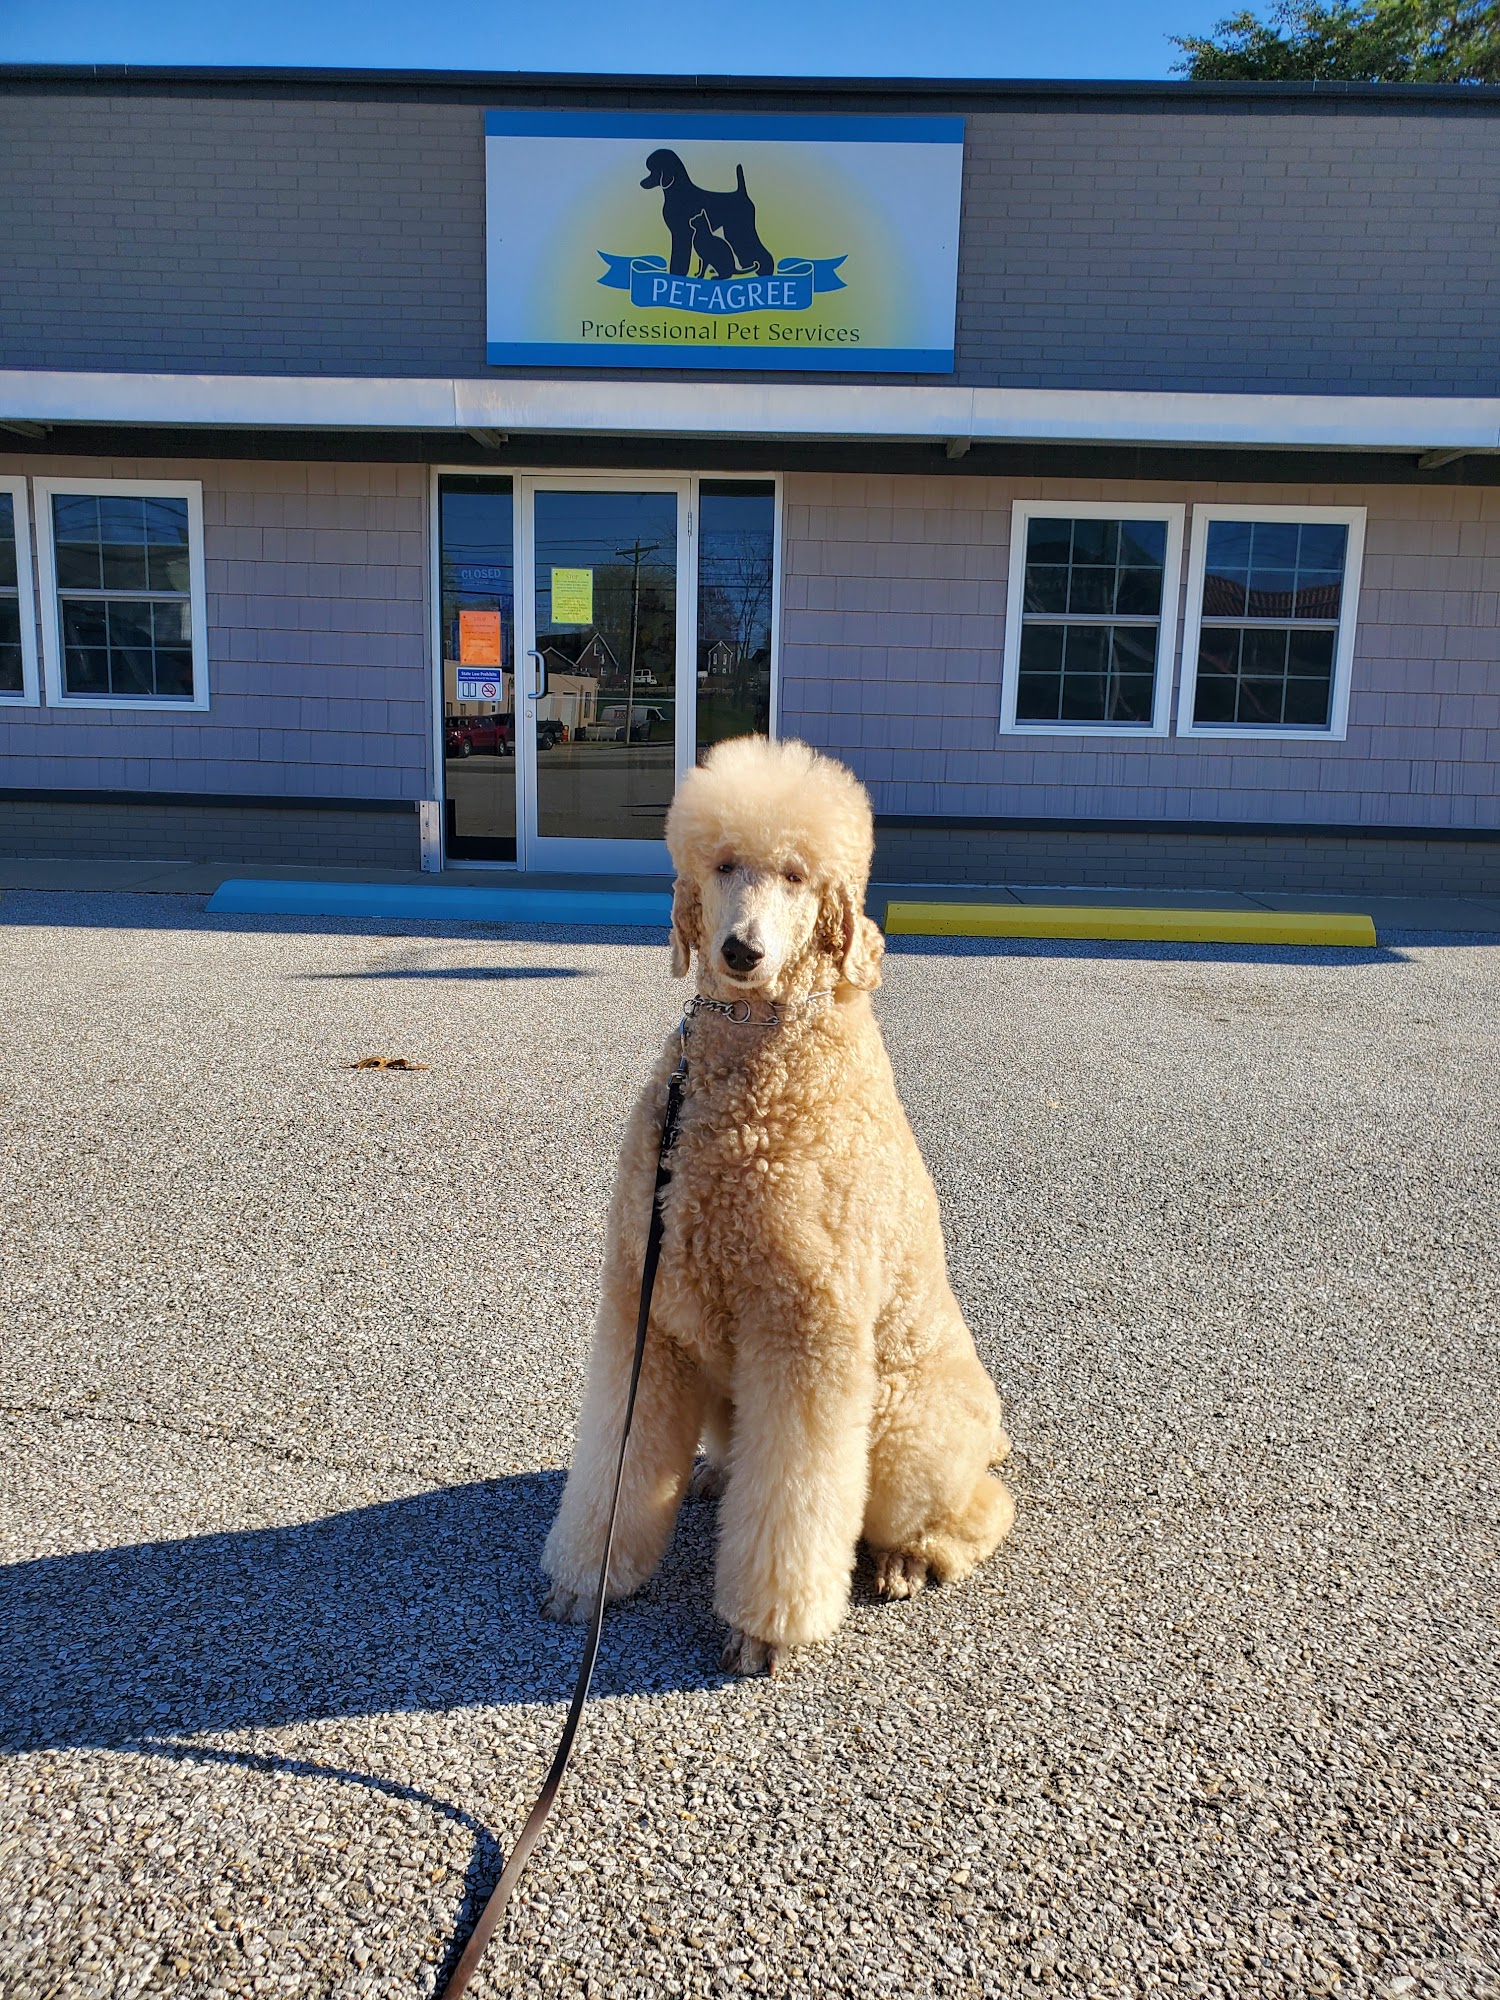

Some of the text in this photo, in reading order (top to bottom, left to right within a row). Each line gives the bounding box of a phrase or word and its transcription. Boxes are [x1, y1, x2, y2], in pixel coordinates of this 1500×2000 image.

[652, 277, 797, 310] PET-AGREE
[581, 319, 860, 342] Professional Pet Services
[461, 568, 501, 580] CLOSED
